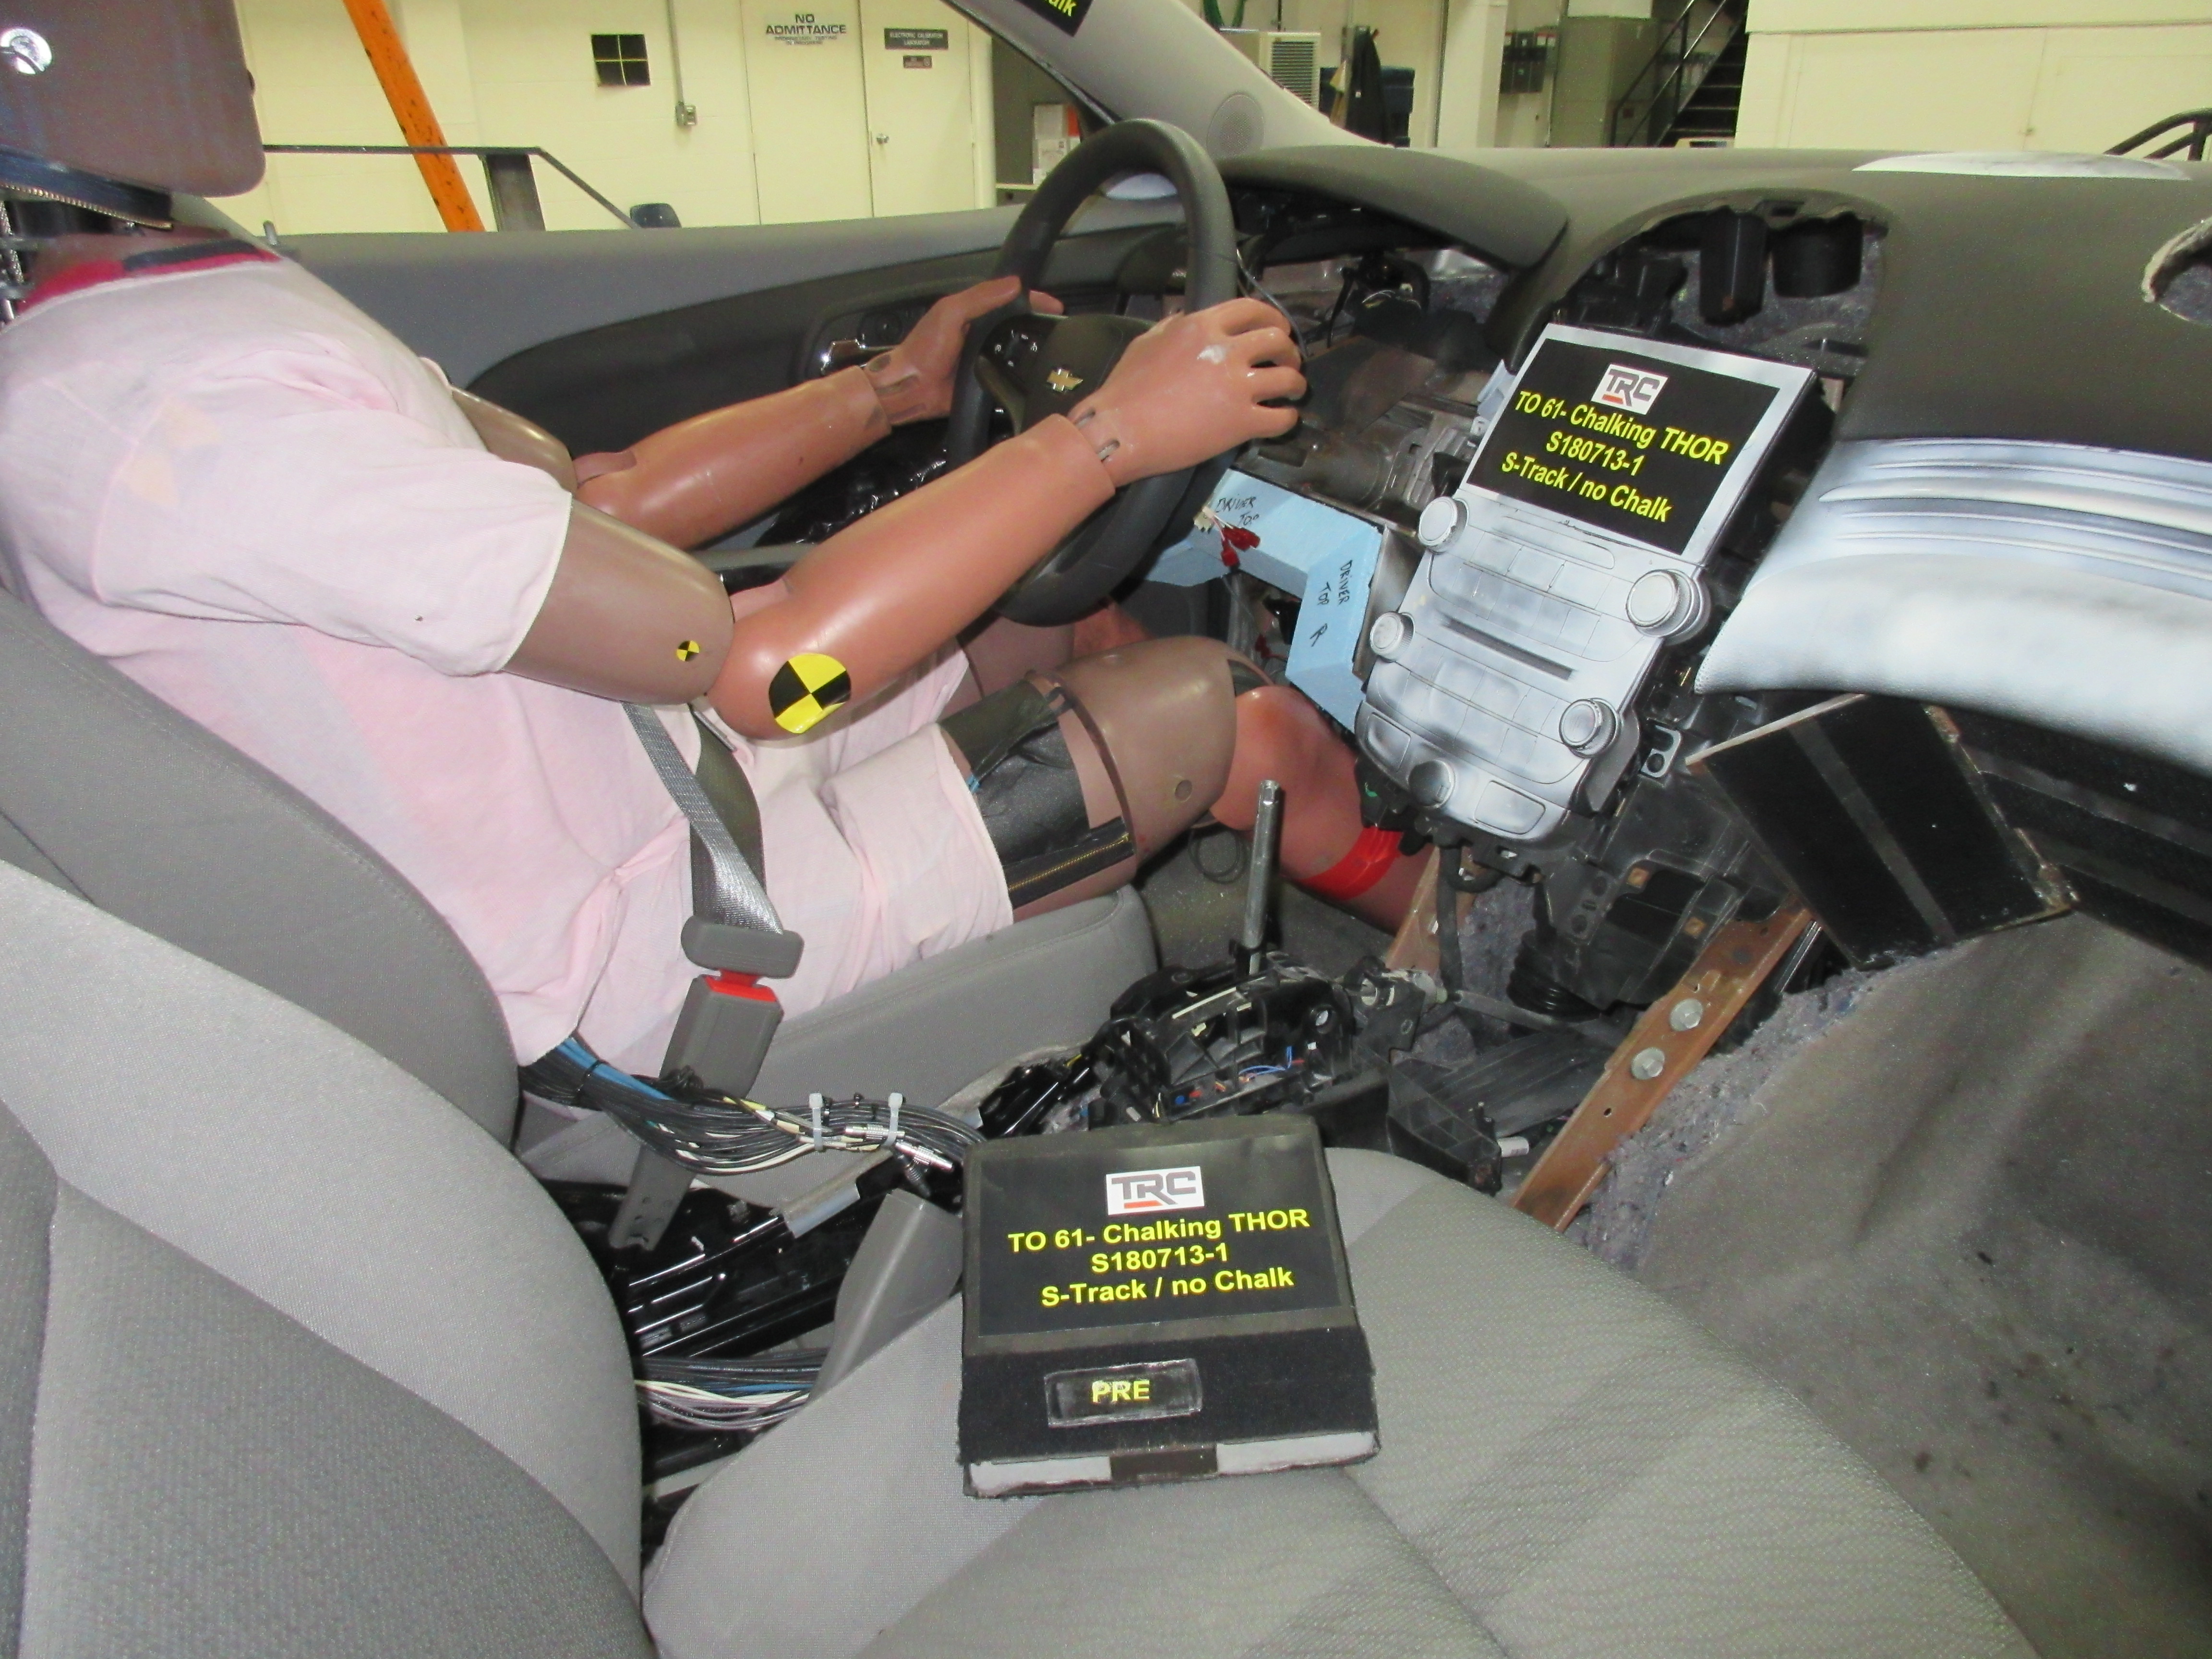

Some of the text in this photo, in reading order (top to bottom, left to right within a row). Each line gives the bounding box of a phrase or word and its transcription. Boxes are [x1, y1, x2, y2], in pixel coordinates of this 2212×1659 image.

[795, 13, 815, 24] NO
[1045, 0, 1077, 17] alk
[766, 24, 847, 35] ADMITTANCE
[1606, 367, 1661, 407] TRC
[1515, 390, 1730, 465] TO 61- Chalking THOR
[1545, 431, 1646, 477] S180713-1
[1214, 494, 1257, 513] DRIVER
[1501, 451, 1570, 489] S-Track
[1579, 480, 1608, 502] no
[1609, 484, 1672, 523] Chalk
[1337, 559, 1353, 606] DRIVER
[1111, 1171, 1197, 1206] TRC
[1007, 1207, 1311, 1253] TO 61- Chalking THOR
[1090, 1241, 1228, 1274] S180713-1
[1040, 1278, 1148, 1309] S-Track
[1170, 1276, 1208, 1297] no
[1213, 1265, 1296, 1293] Chalk
[1091, 1379, 1151, 1404] PRE
